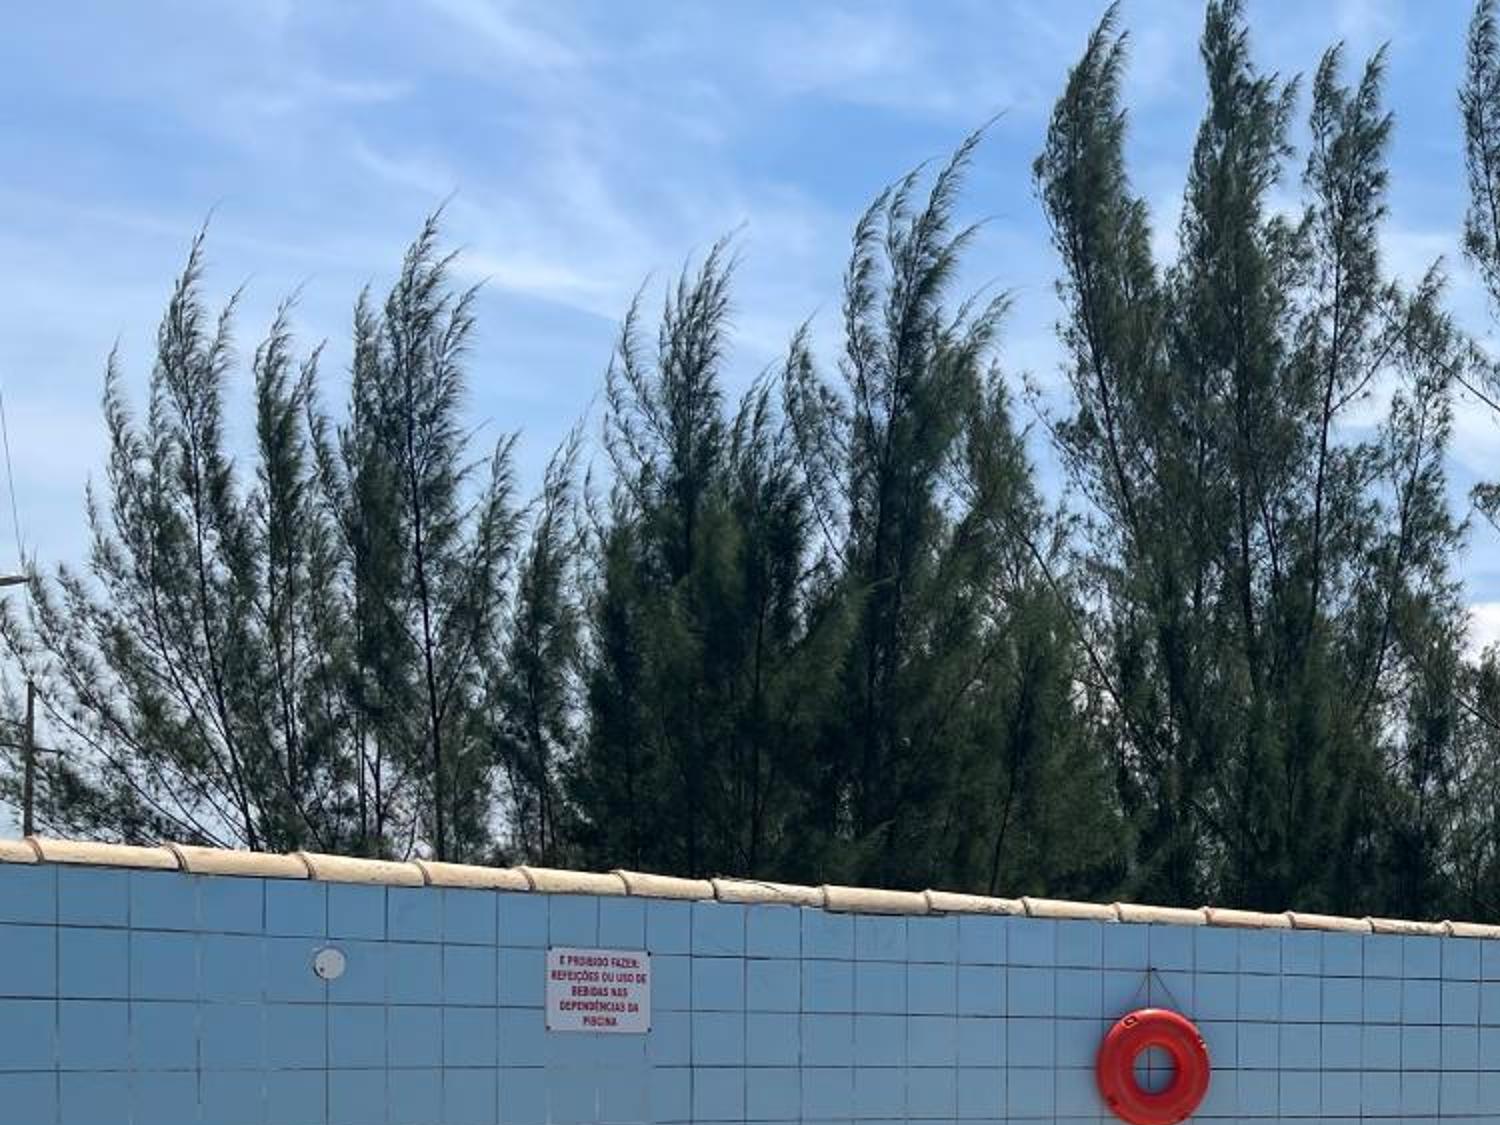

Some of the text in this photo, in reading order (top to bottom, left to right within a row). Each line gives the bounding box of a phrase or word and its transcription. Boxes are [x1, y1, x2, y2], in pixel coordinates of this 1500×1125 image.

[568, 955, 608, 967] PROIBIDO
[602, 971, 614, 982] OU
[616, 973, 634, 983] USO
[636, 973, 647, 984] DE
[572, 985, 628, 997] BEBIDAS NAS
[627, 1002, 639, 1013] DA
[583, 1015, 617, 1026] PISCINA
